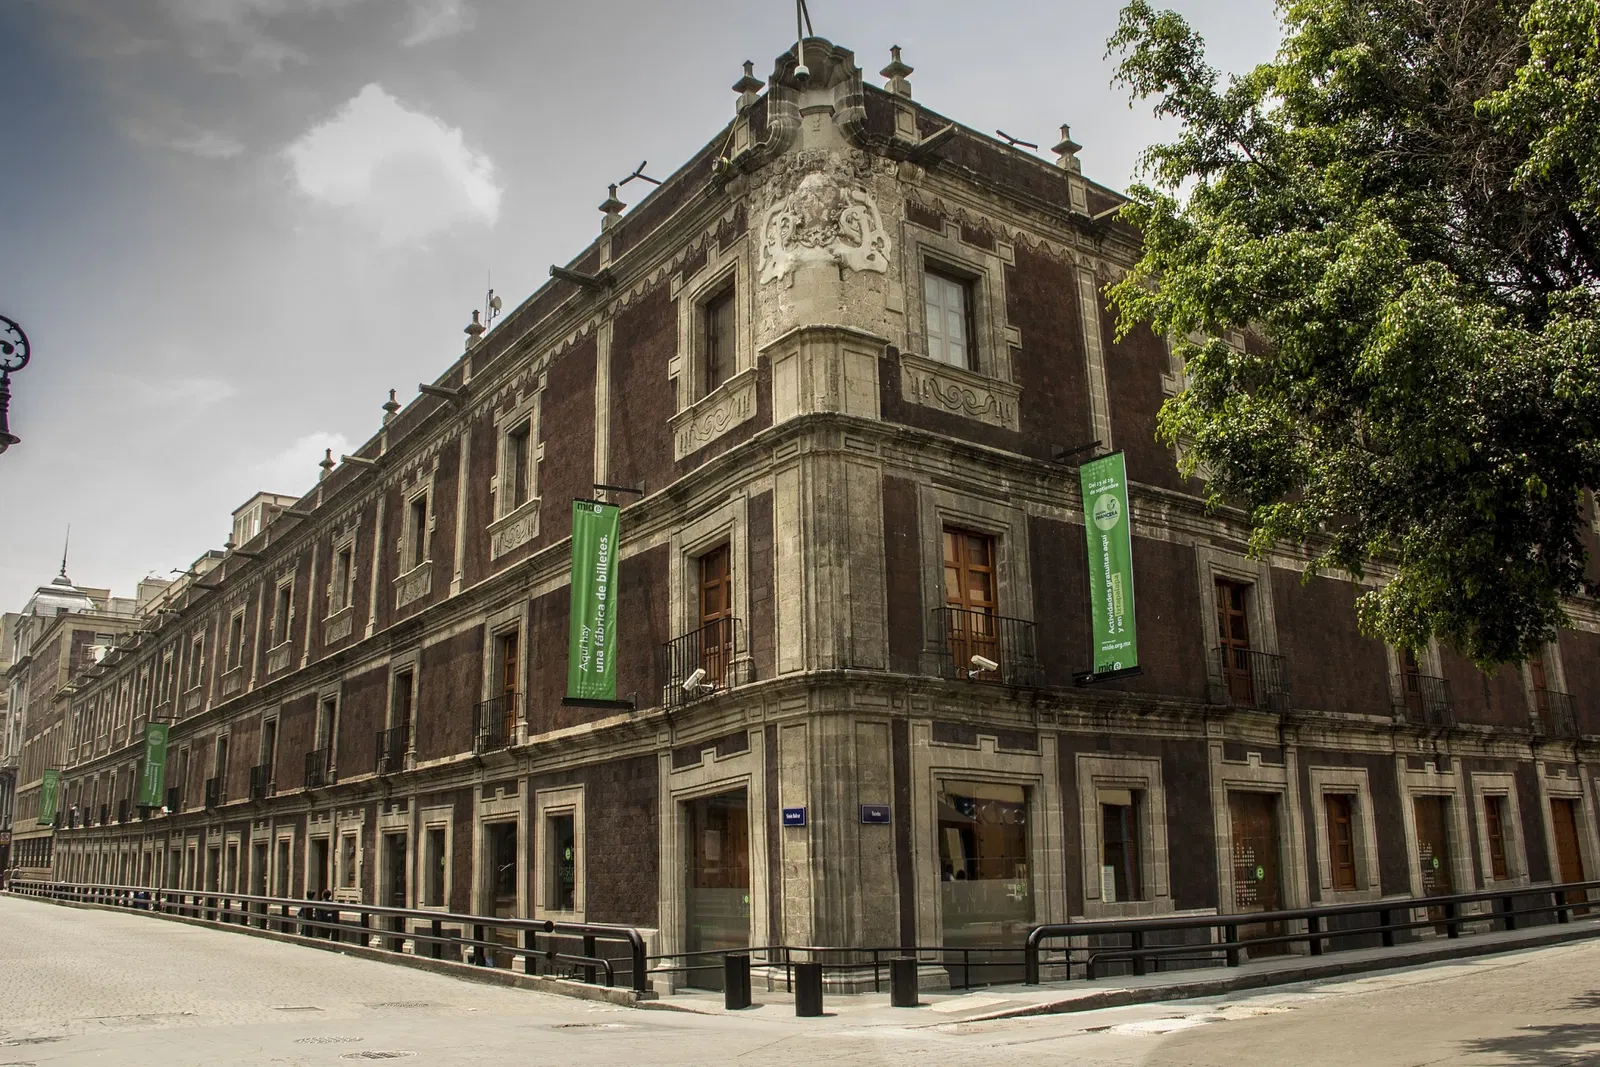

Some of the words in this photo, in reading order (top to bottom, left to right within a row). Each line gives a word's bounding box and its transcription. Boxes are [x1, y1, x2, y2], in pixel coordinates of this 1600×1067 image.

[1101, 534, 1109, 552] aquí
[596, 534, 608, 583] billetes.
[1104, 552, 1112, 588] gratuitas
[596, 585, 606, 601] de
[1107, 588, 1115, 634] Actividades
[1117, 616, 1122, 627] en
[579, 624, 592, 643] hay
[595, 604, 605, 647] fábrica
[579, 643, 591, 672] Aquí
[596, 650, 604, 673] una
